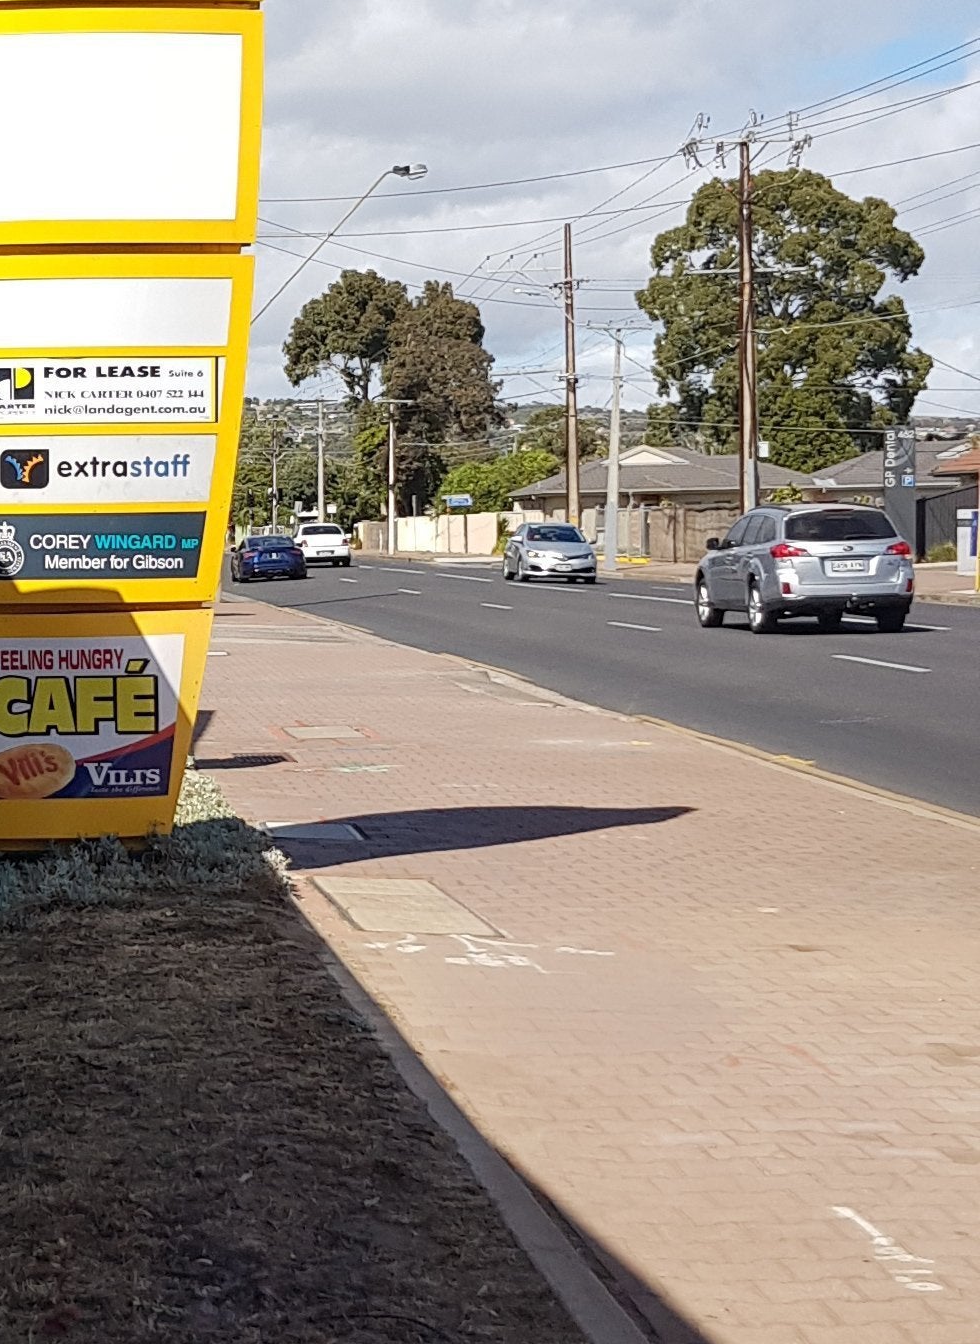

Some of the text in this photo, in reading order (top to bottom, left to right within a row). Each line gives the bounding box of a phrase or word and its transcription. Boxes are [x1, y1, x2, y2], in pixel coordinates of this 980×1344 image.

[44, 367, 86, 378] FOR
[96, 366, 161, 377] LEASE
[44, 390, 76, 399] NICK
[81, 390, 133, 399] CARTER
[136, 389, 162, 398] 0407
[44, 404, 206, 416] nick@landagent.com.au
[57, 454, 191, 477] extrastaff
[885, 471, 896, 487] GP
[30, 534, 199, 549] COREY WINGARD MP
[44, 553, 184, 569] Member for Gibson
[58, 649, 124, 669] HUNGRY
